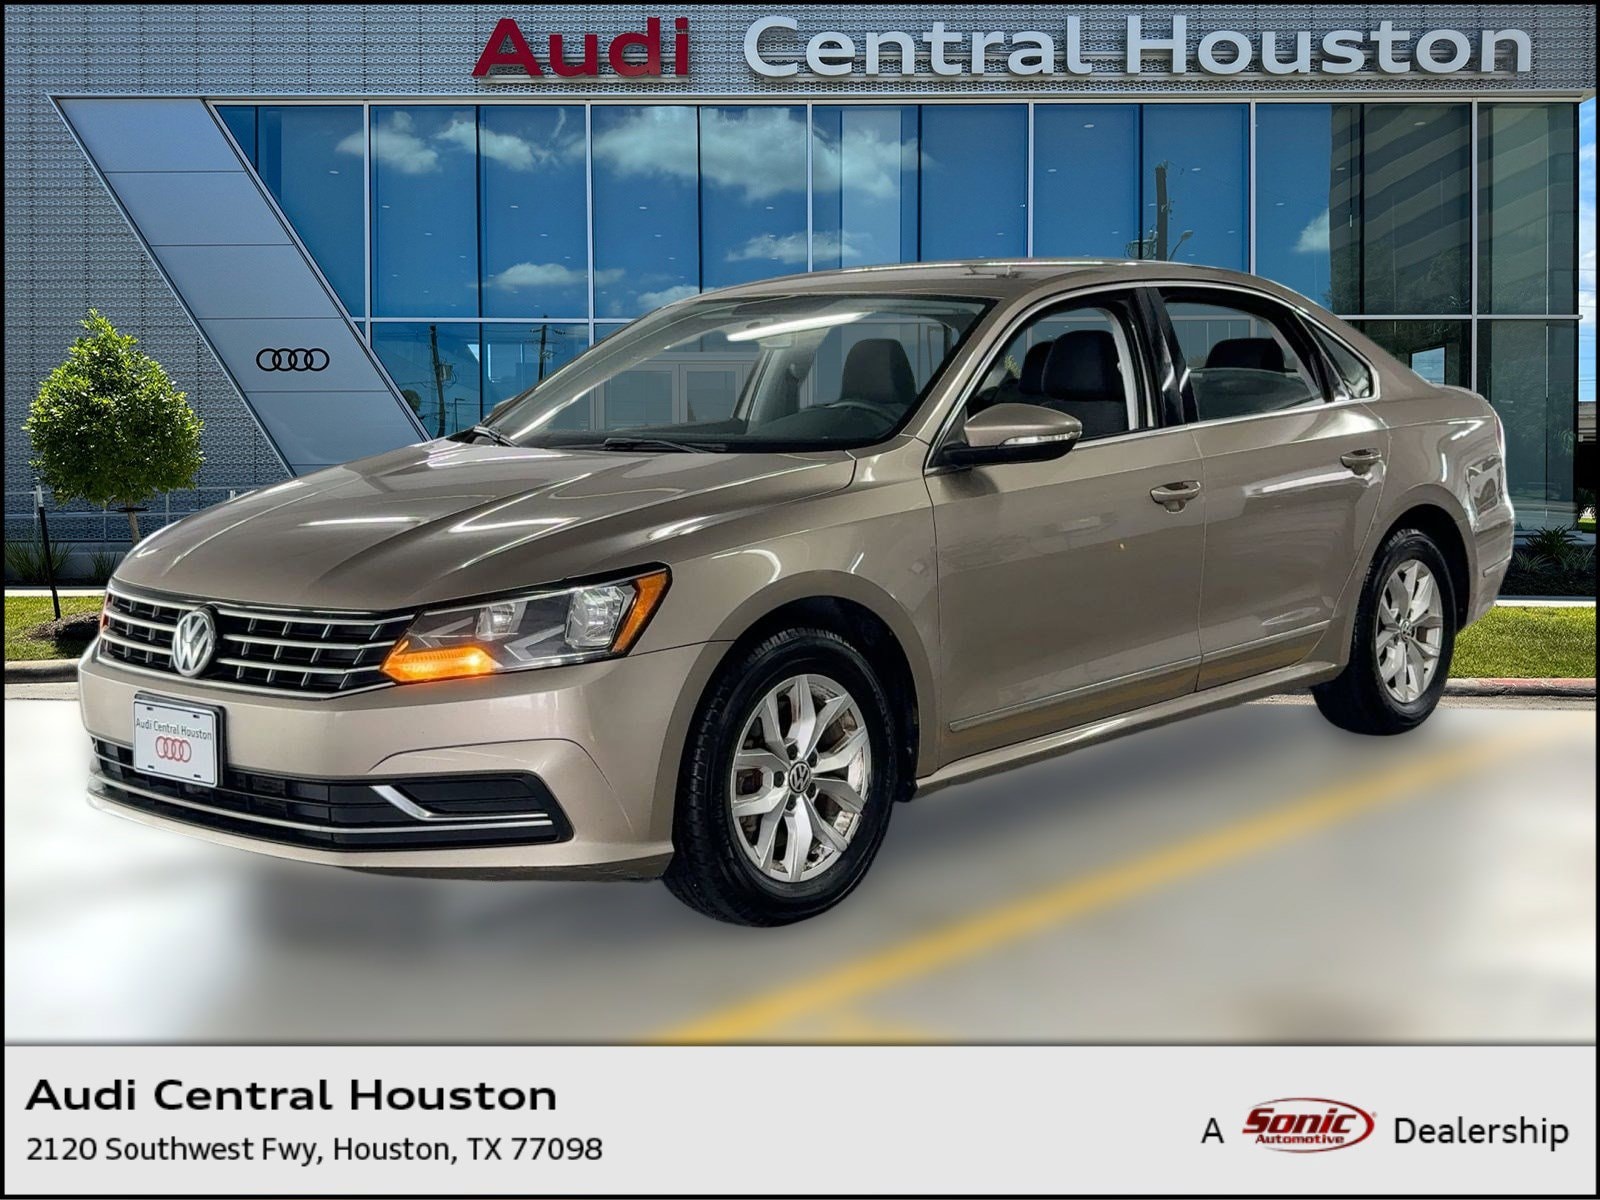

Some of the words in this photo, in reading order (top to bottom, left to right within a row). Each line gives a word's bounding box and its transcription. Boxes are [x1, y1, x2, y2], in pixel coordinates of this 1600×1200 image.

[472, 17, 691, 79] Audi
[743, 15, 1092, 76] Central
[1126, 15, 1531, 75] Houston
[136, 718, 152, 729] Audi
[153, 721, 180, 735] Central
[181, 726, 212, 740] Houston
